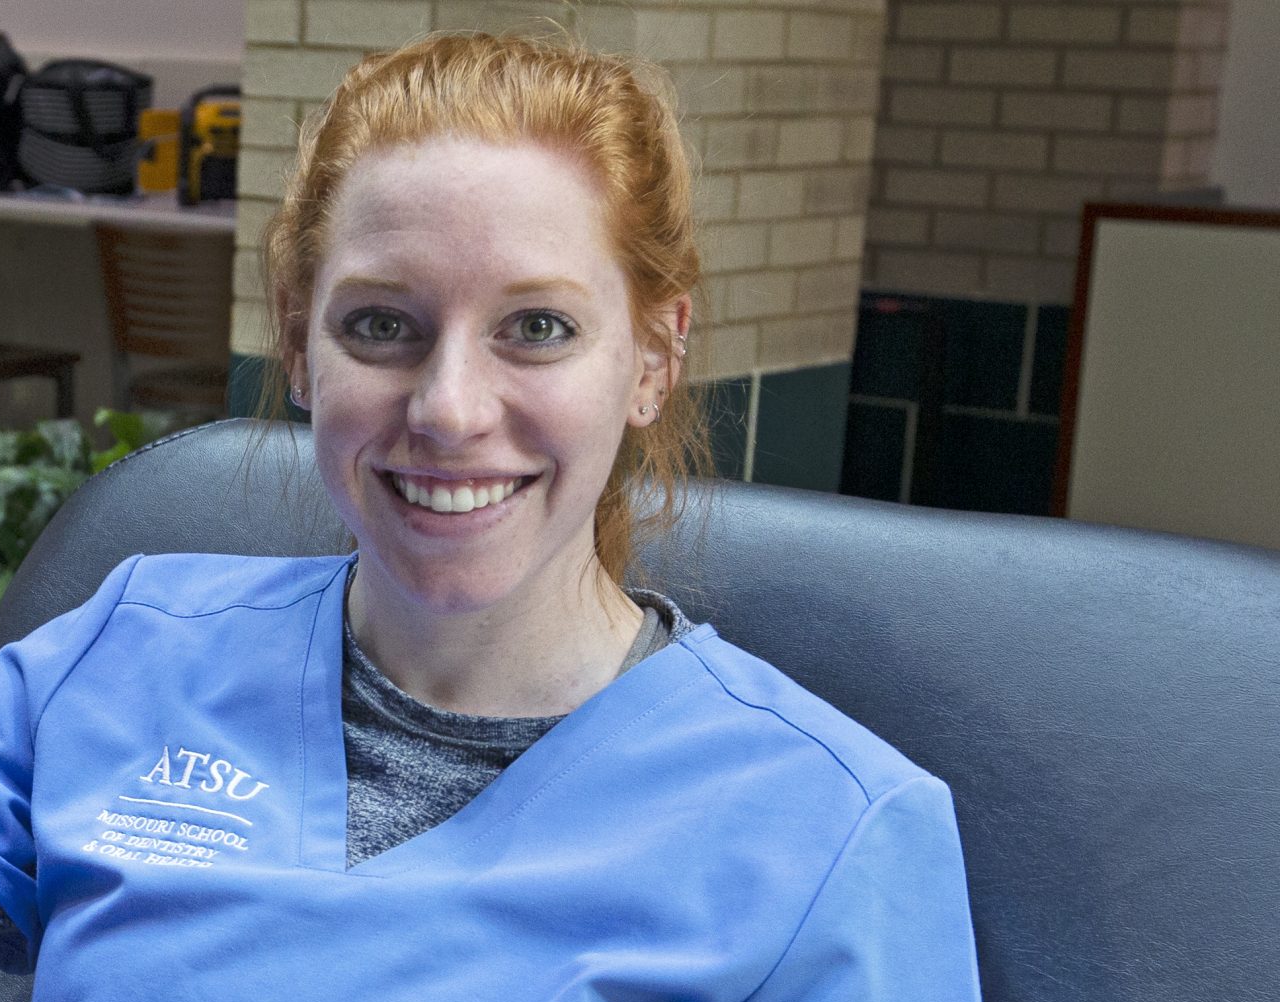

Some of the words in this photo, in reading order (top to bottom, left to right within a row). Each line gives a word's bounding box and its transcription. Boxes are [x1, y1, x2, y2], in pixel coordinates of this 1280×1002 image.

[139, 745, 270, 801] ATSU
[96, 809, 175, 834] MISSOURI
[177, 822, 249, 850] SCHOOL
[101, 830, 126, 842] OF
[124, 835, 219, 859] DENTISTRY
[81, 840, 98, 852] &
[100, 844, 142, 861] ORAL
